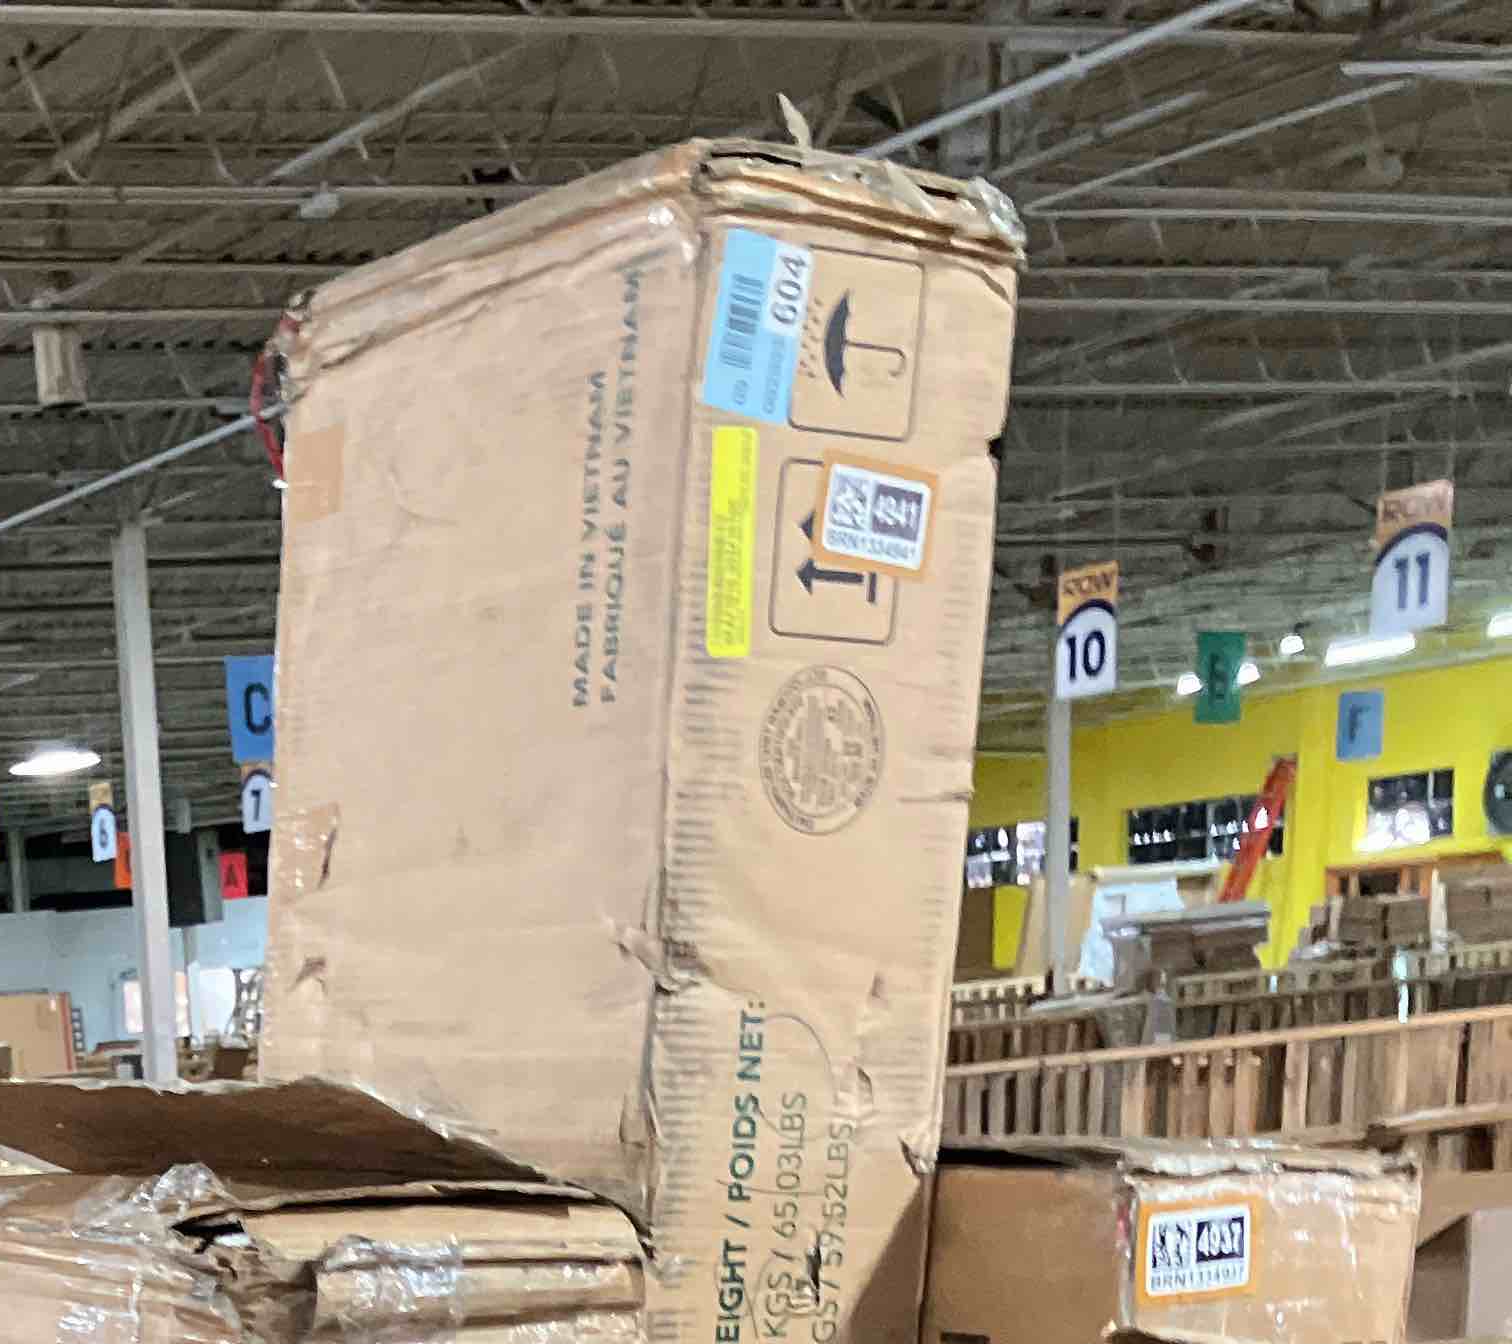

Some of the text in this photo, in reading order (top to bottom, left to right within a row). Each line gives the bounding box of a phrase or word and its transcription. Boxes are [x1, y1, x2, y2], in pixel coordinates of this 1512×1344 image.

[615, 270, 642, 449] VIETNAM
[610, 457, 631, 510] AU
[570, 371, 609, 706] MADE IN VIETNAM
[1395, 552, 1431, 610] 11
[1066, 631, 1106, 681] 10
[244, 682, 273, 735] C
[735, 1000, 766, 1084] NET:
[727, 1094, 759, 1201] POIDS
[771, 1092, 807, 1240] 65.03LBS
[760, 1272, 794, 1339] KGS
